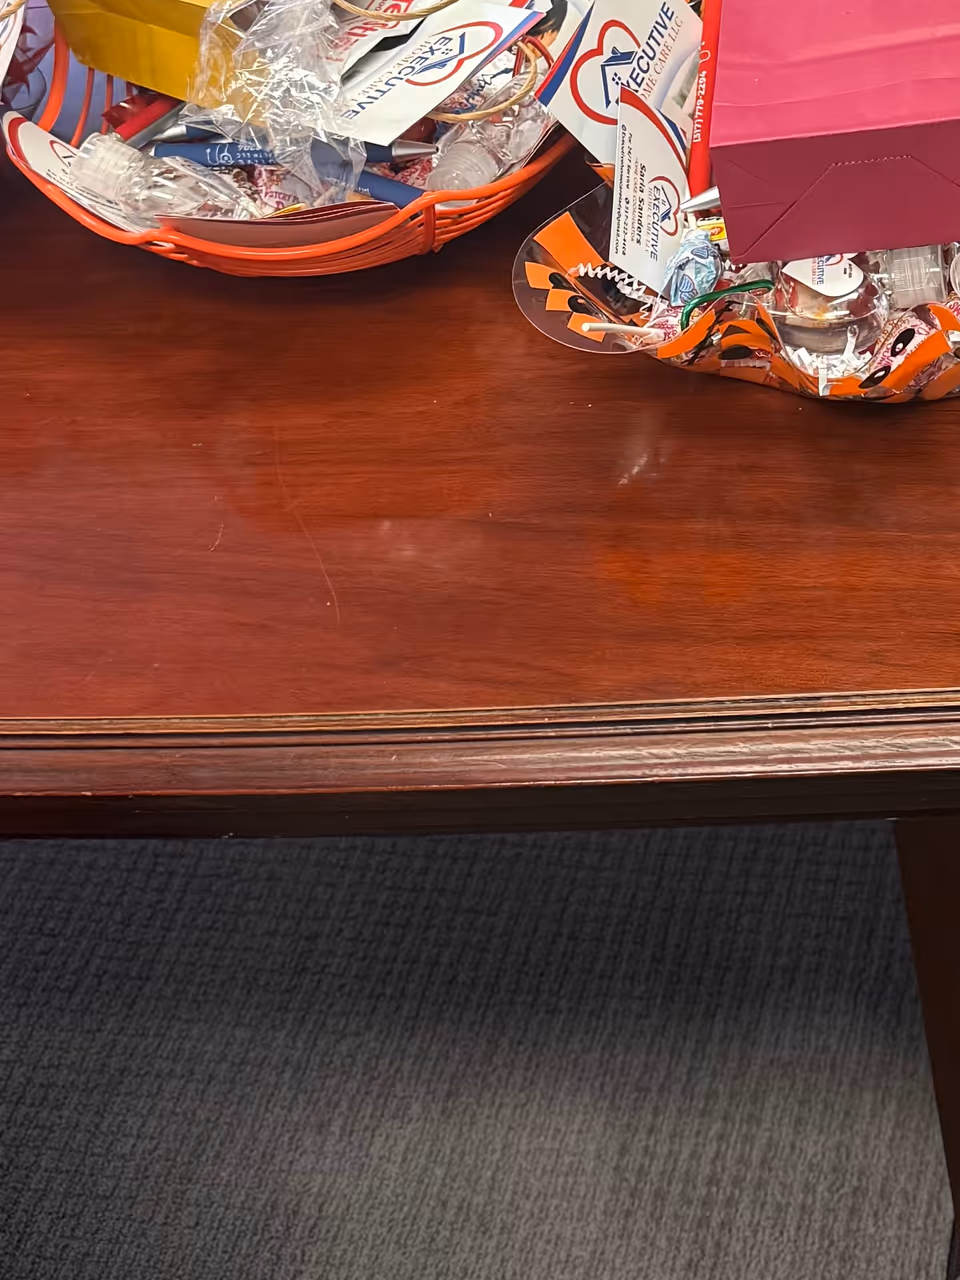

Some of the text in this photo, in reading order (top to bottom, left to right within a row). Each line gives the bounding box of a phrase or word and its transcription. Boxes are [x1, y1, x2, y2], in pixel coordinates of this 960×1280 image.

[341, 35, 454, 120] EXECUTIVE
[621, 1, 675, 94] XECUTIVE
[654, 41, 673, 72] CARE
[635, 195, 645, 246] Sanders
[649, 184, 661, 262] EXECUTIVE
